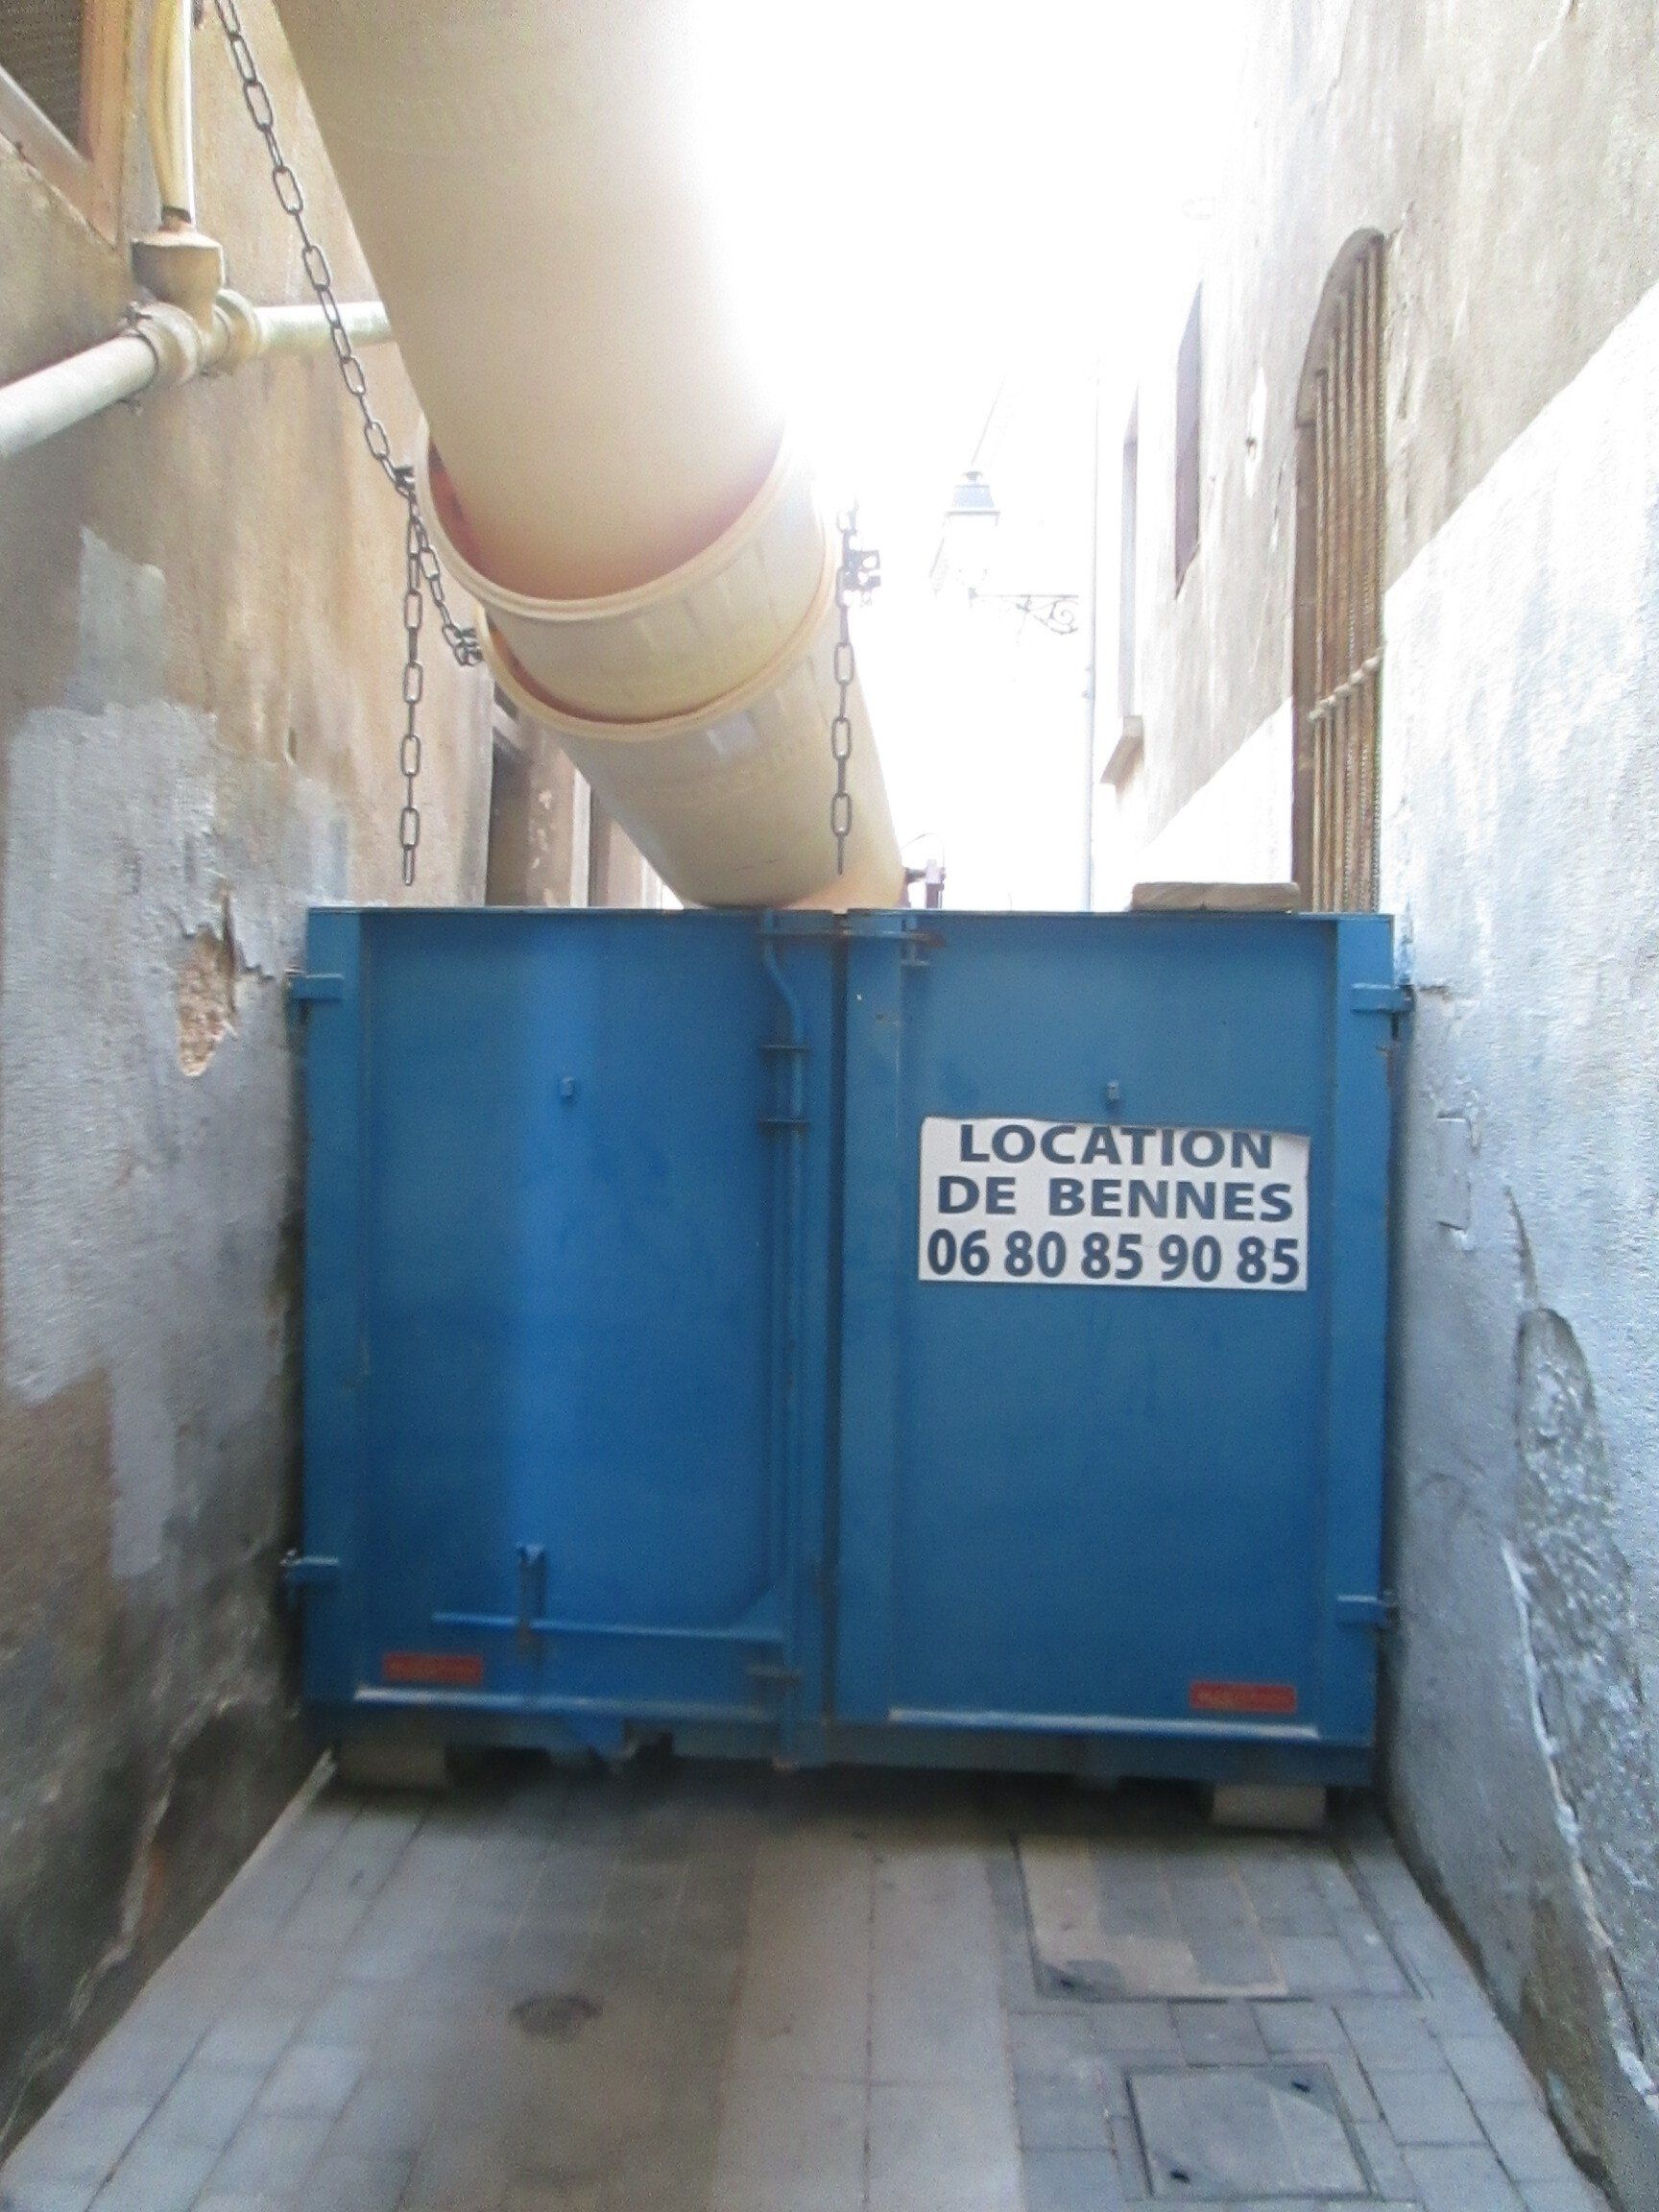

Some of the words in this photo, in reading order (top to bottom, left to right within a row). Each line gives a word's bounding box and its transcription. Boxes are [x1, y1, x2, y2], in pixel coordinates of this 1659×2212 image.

[960, 1124, 1272, 1168] LOCATION
[938, 1176, 1016, 1215] DE
[1049, 1178, 1293, 1222] BENNES
[927, 1229, 990, 1276] 06
[1004, 1231, 1067, 1278] 80
[1081, 1232, 1143, 1280] 85
[1159, 1235, 1222, 1283] 90
[1237, 1237, 1300, 1285] 85
